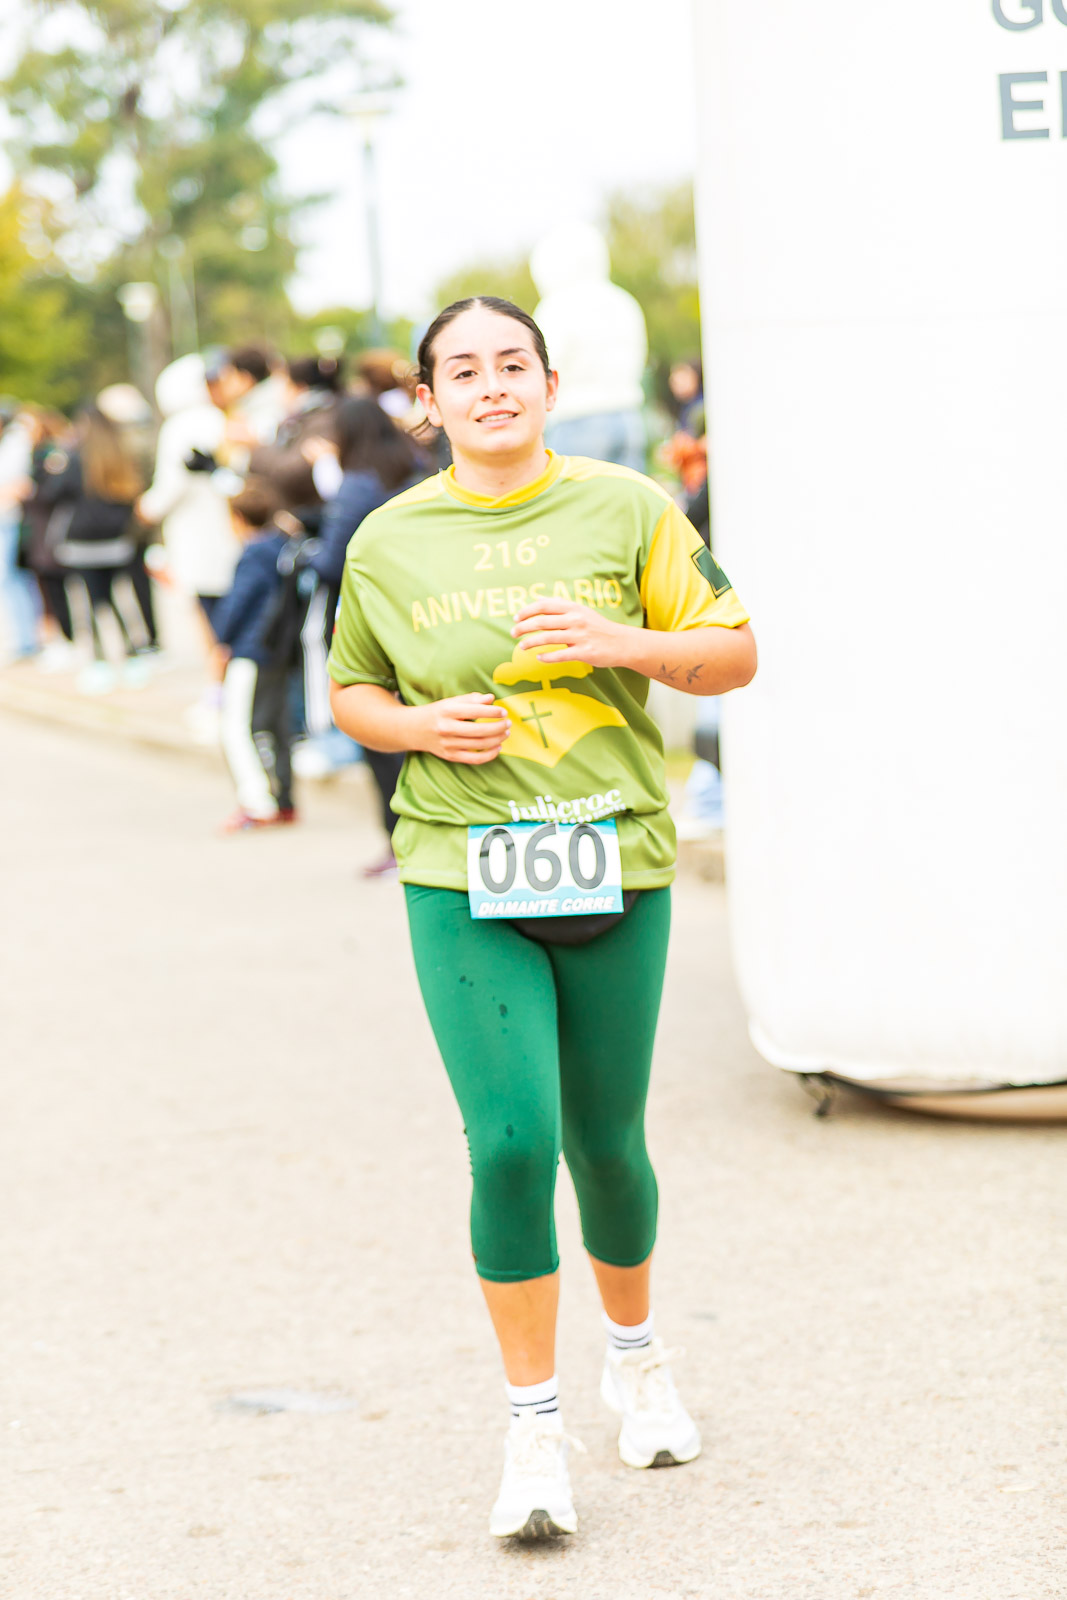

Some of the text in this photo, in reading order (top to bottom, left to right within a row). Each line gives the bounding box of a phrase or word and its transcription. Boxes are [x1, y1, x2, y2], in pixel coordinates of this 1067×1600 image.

[998, 71, 1067, 140] E
[479, 823, 606, 894] 060
[478, 896, 615, 917] DIAMANTE CORRE
